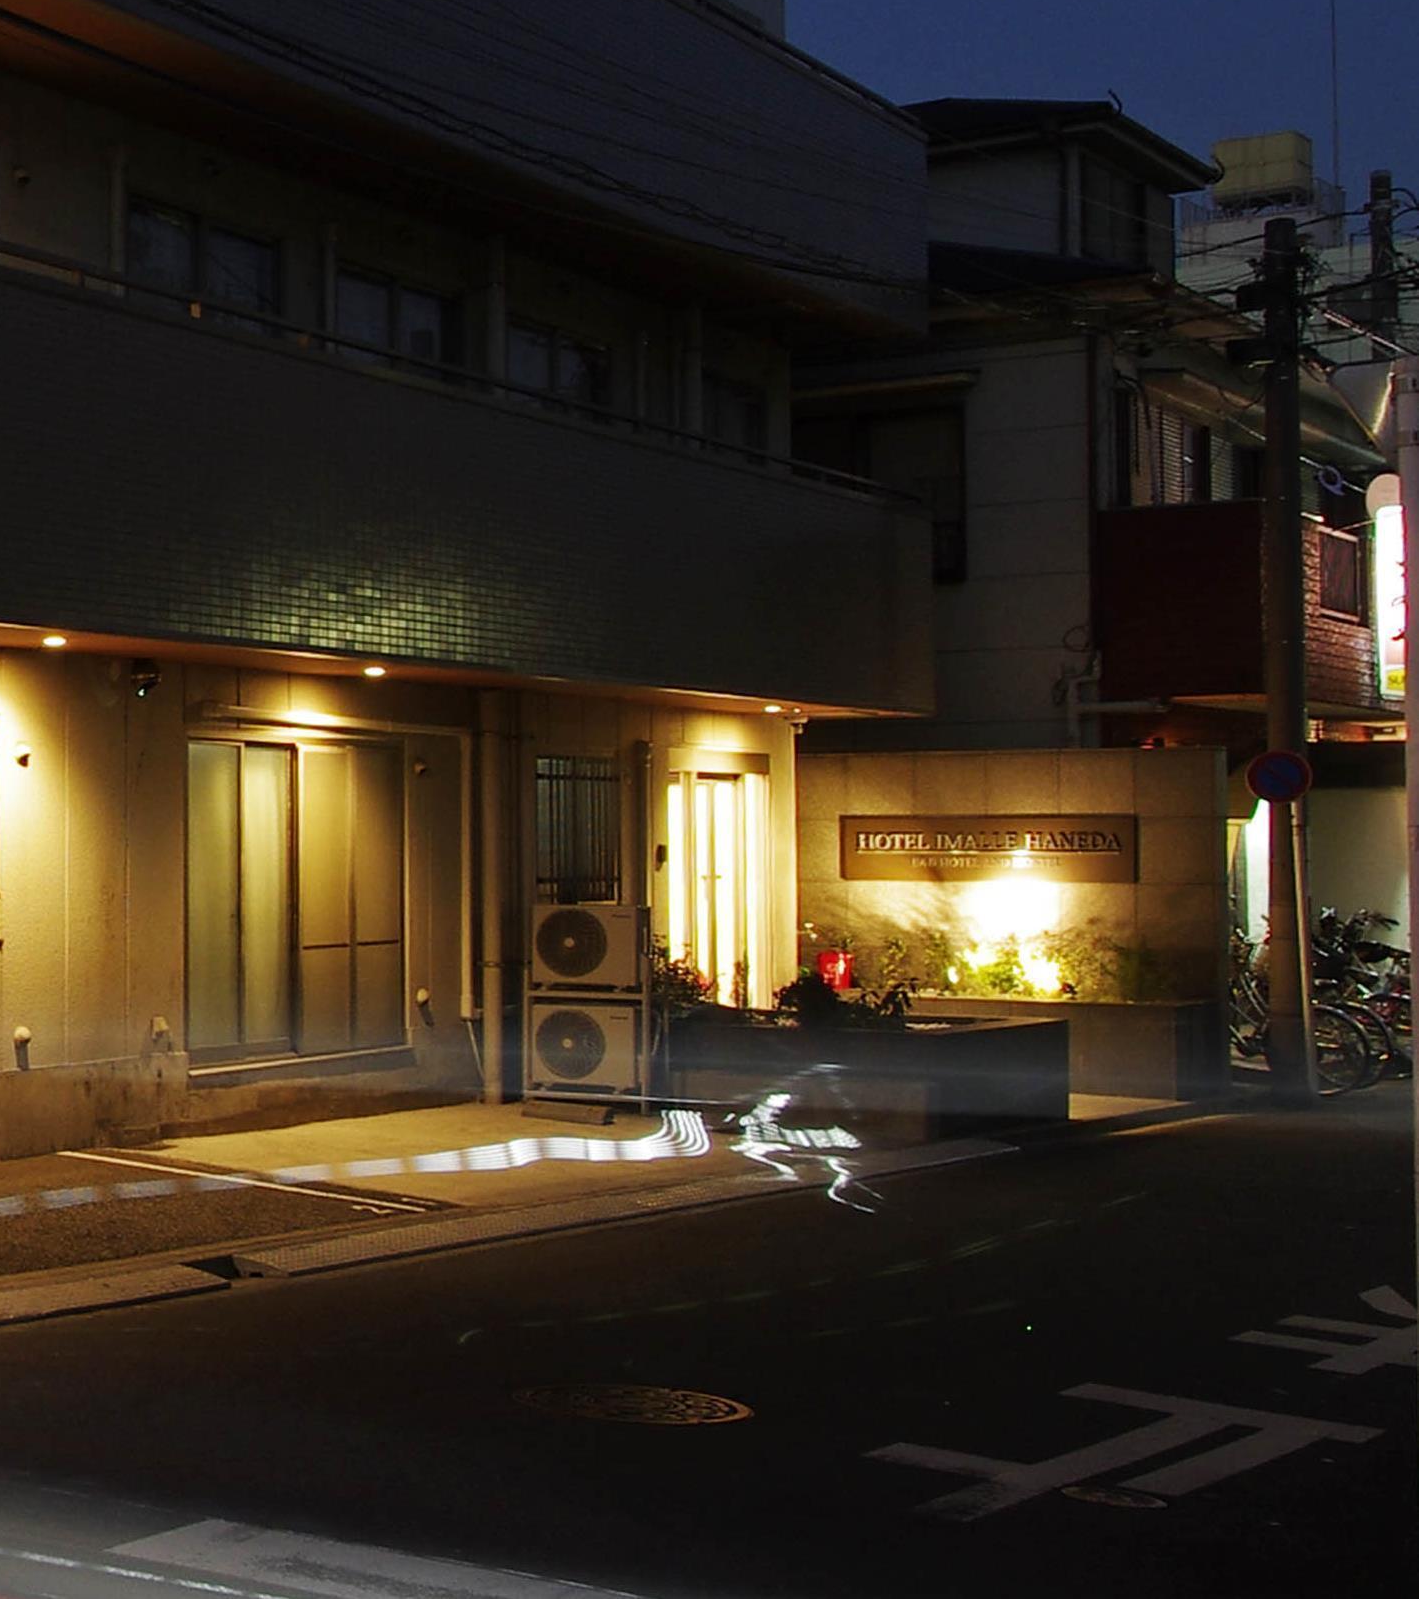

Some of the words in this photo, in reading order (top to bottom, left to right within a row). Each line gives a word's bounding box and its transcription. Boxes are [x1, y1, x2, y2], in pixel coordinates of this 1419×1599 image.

[856, 831, 931, 851] HOTEL
[936, 831, 1019, 851] IMALLE
[1023, 830, 1122, 851] HANEDA
